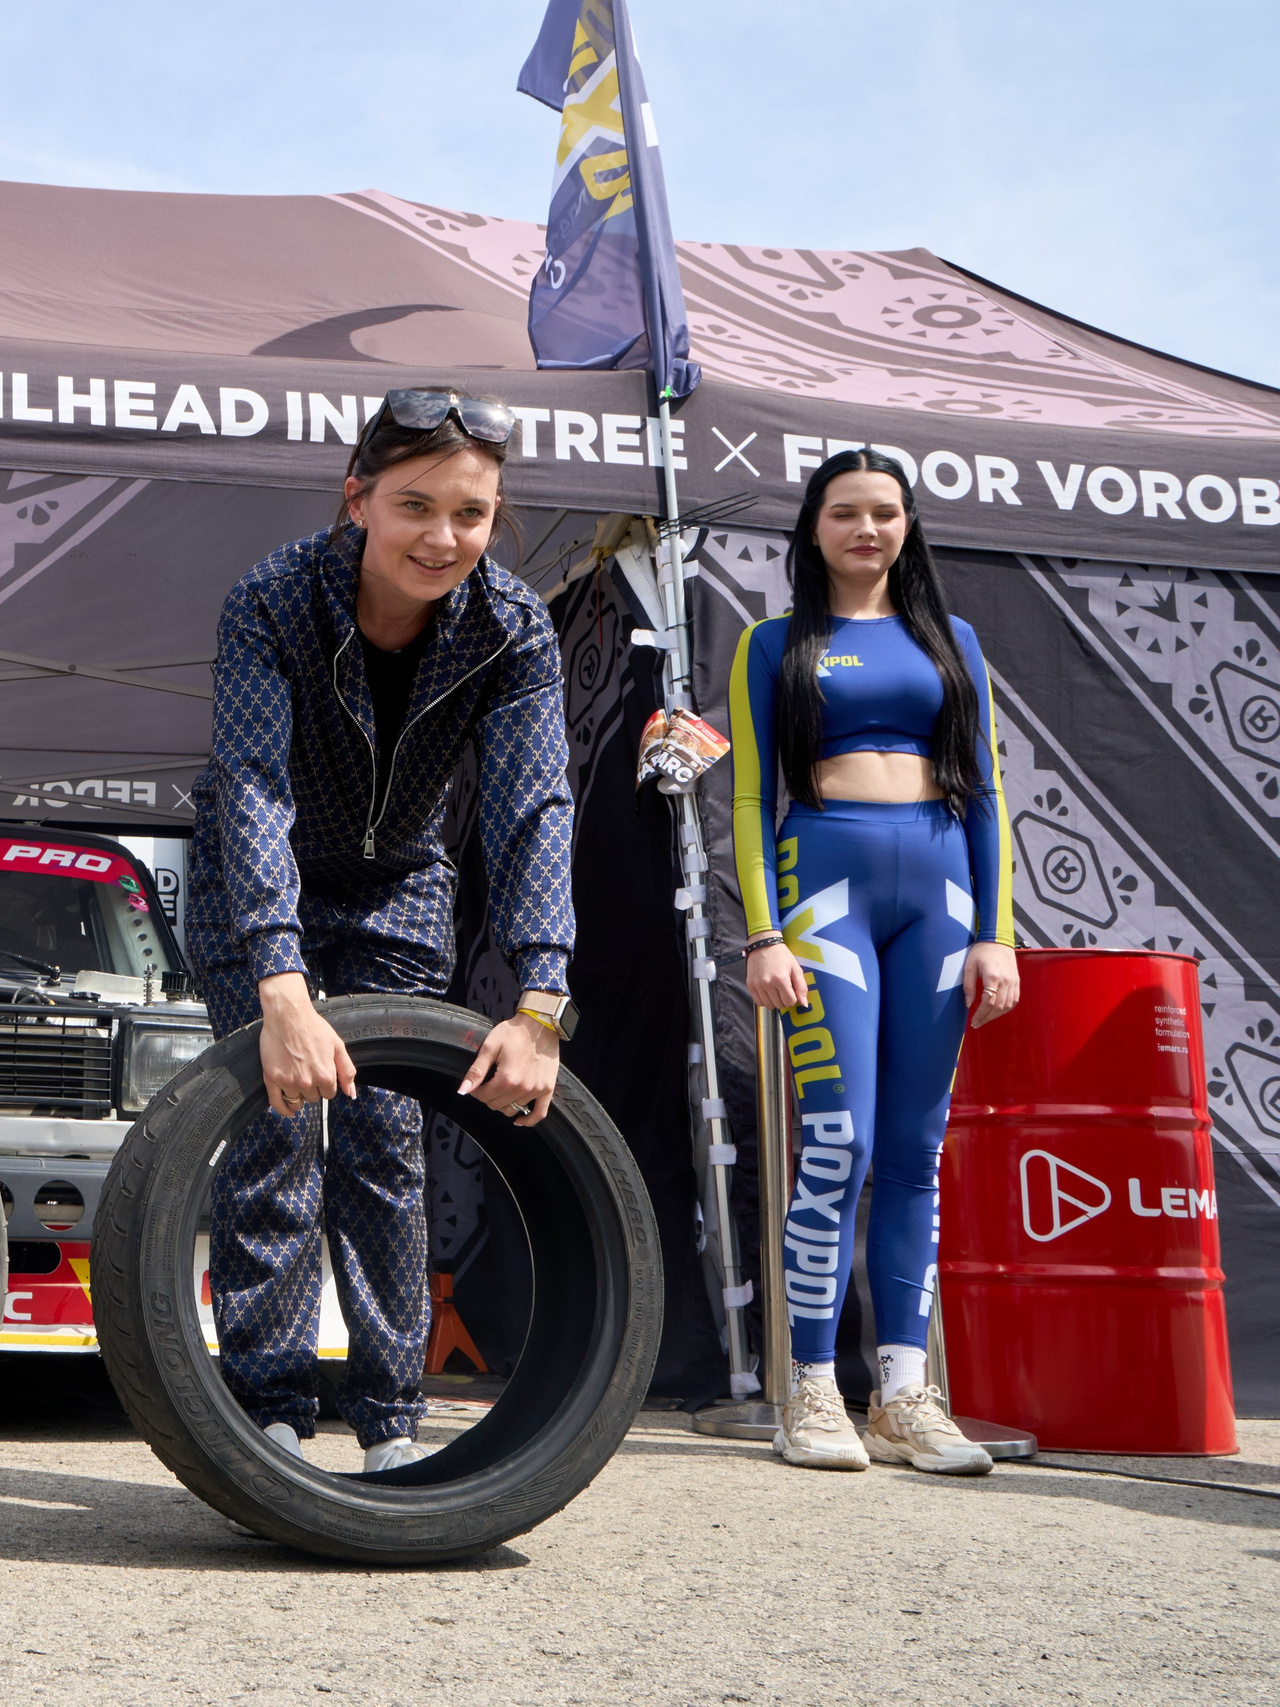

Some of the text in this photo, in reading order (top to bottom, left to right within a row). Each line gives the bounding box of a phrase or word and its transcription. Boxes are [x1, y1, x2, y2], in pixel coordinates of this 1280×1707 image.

[286, 391, 688, 470] INTREE
[2, 844, 112, 873] PRO
[1154, 1005, 1187, 1016] reinforced
[1155, 1017, 1185, 1027] synthetic
[1155, 1027, 1190, 1039] formulation
[784, 1109, 855, 1327] POXIPOL
